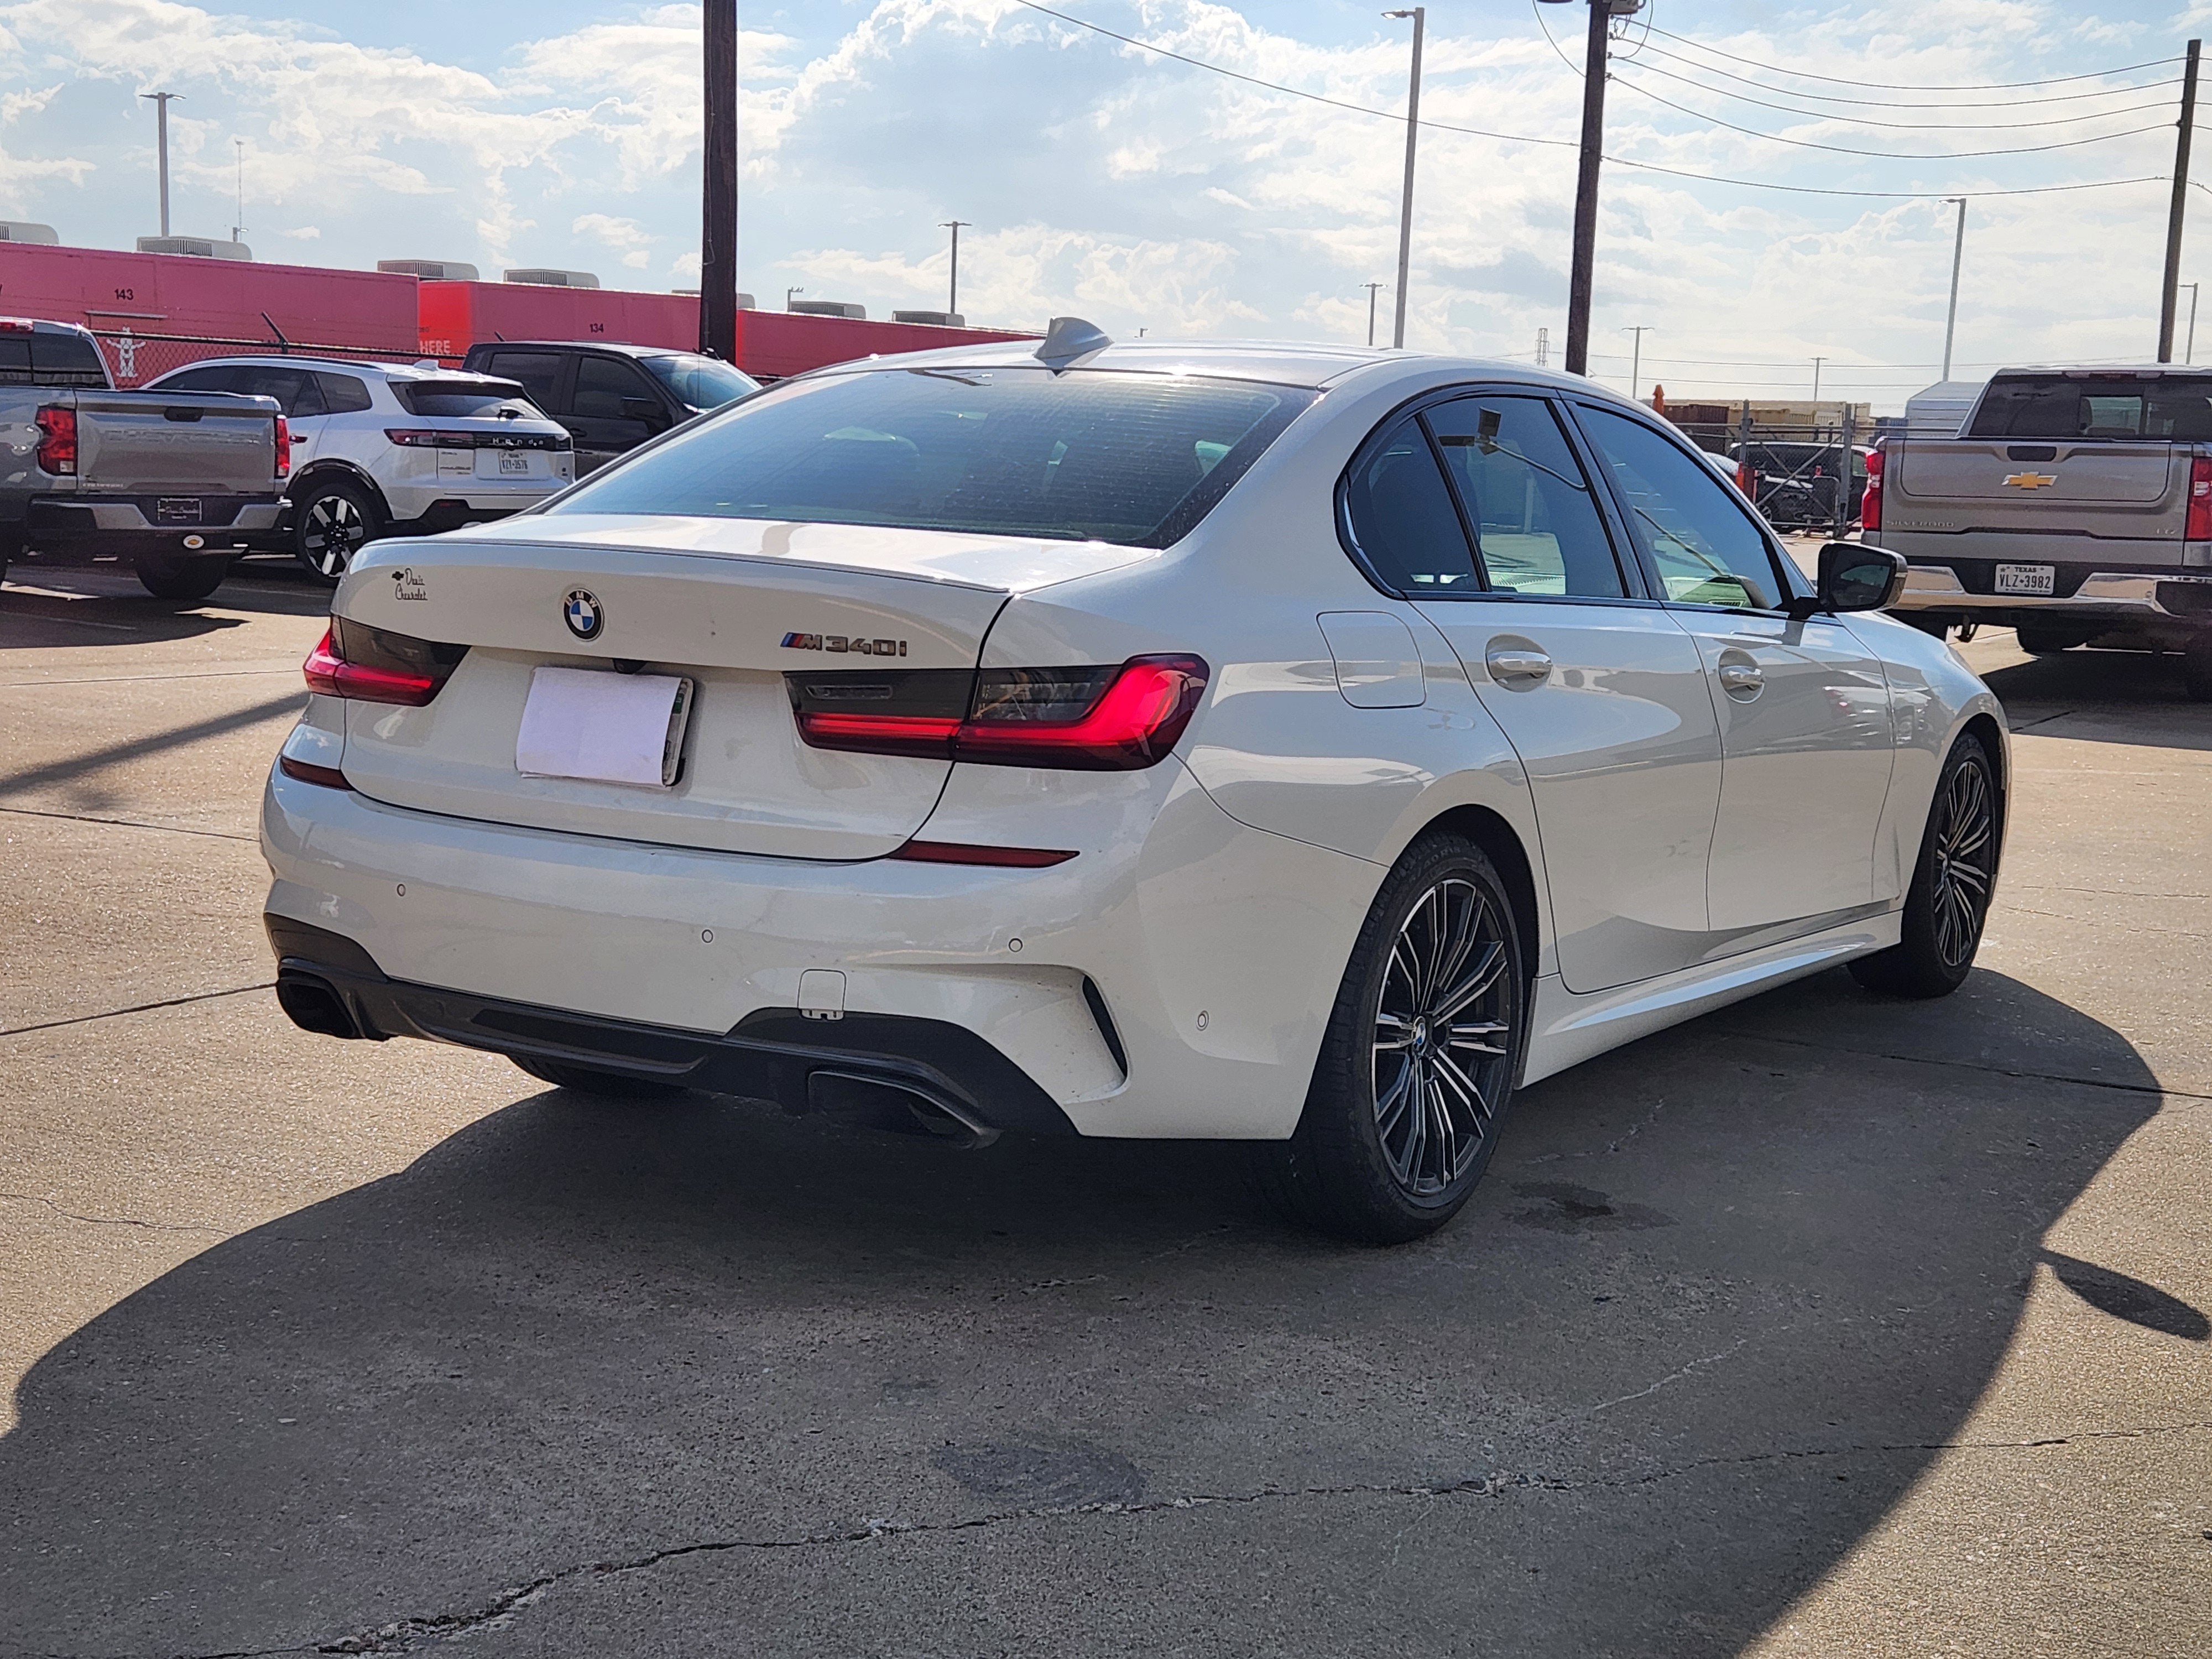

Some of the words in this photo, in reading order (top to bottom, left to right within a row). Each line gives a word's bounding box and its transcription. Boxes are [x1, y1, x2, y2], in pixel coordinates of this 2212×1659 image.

[114, 289, 134, 300] 143
[589, 323, 604, 333] 134
[420, 340, 451, 354] HERE
[564, 591, 598, 608] BMW
